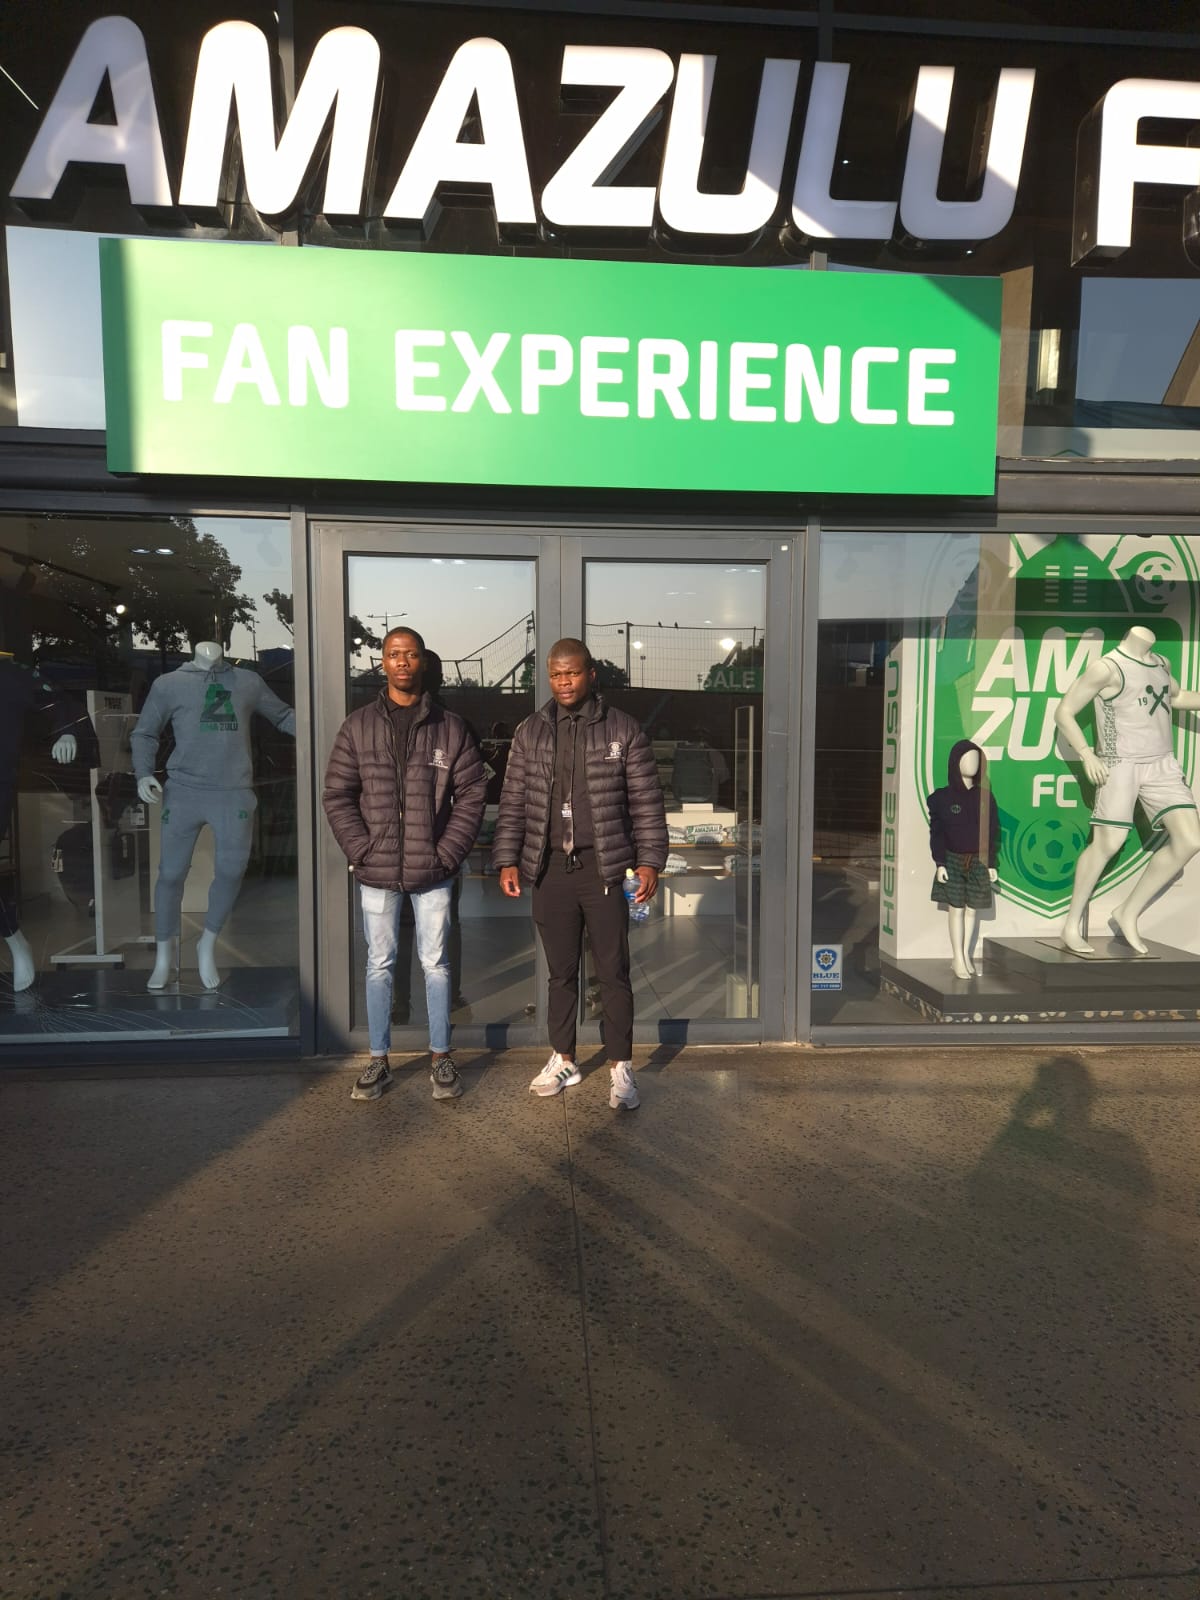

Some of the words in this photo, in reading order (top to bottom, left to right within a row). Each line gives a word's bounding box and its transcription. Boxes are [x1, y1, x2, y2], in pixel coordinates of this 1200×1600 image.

[9, 15, 1036, 240] AMAZULU
[1097, 78, 1200, 248] F
[160, 320, 349, 408] FAN
[394, 329, 957, 426] EXPERIENCE
[1032, 773, 1078, 808] FC
[882, 791, 896, 936] HEBE
